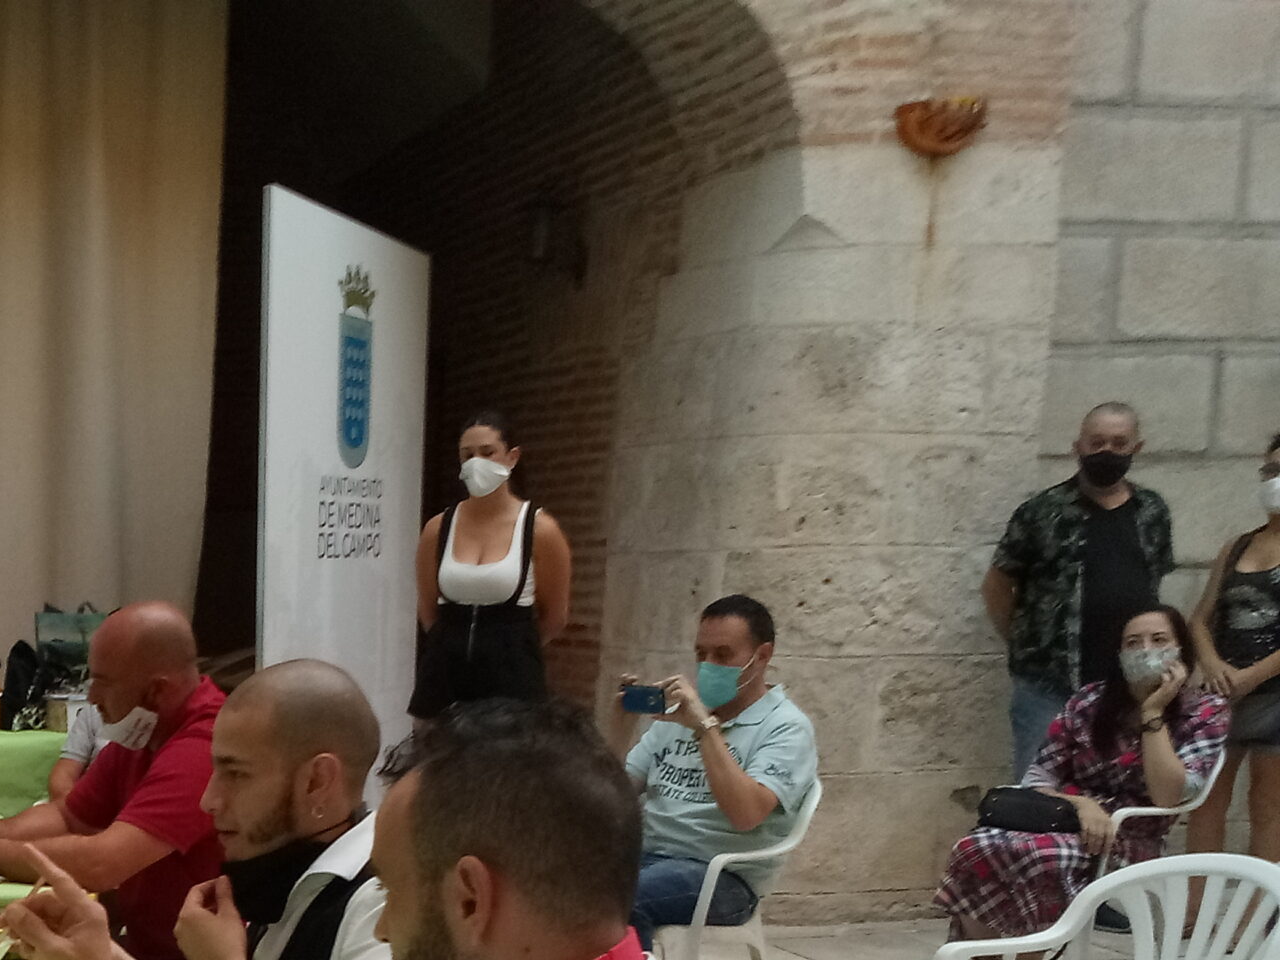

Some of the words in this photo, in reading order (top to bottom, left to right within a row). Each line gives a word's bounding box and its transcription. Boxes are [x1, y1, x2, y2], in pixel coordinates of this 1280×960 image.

[319, 501, 335, 528] DE
[338, 502, 380, 528] MEDINA
[318, 532, 340, 558] DEL
[342, 532, 380, 558] CAMPO
